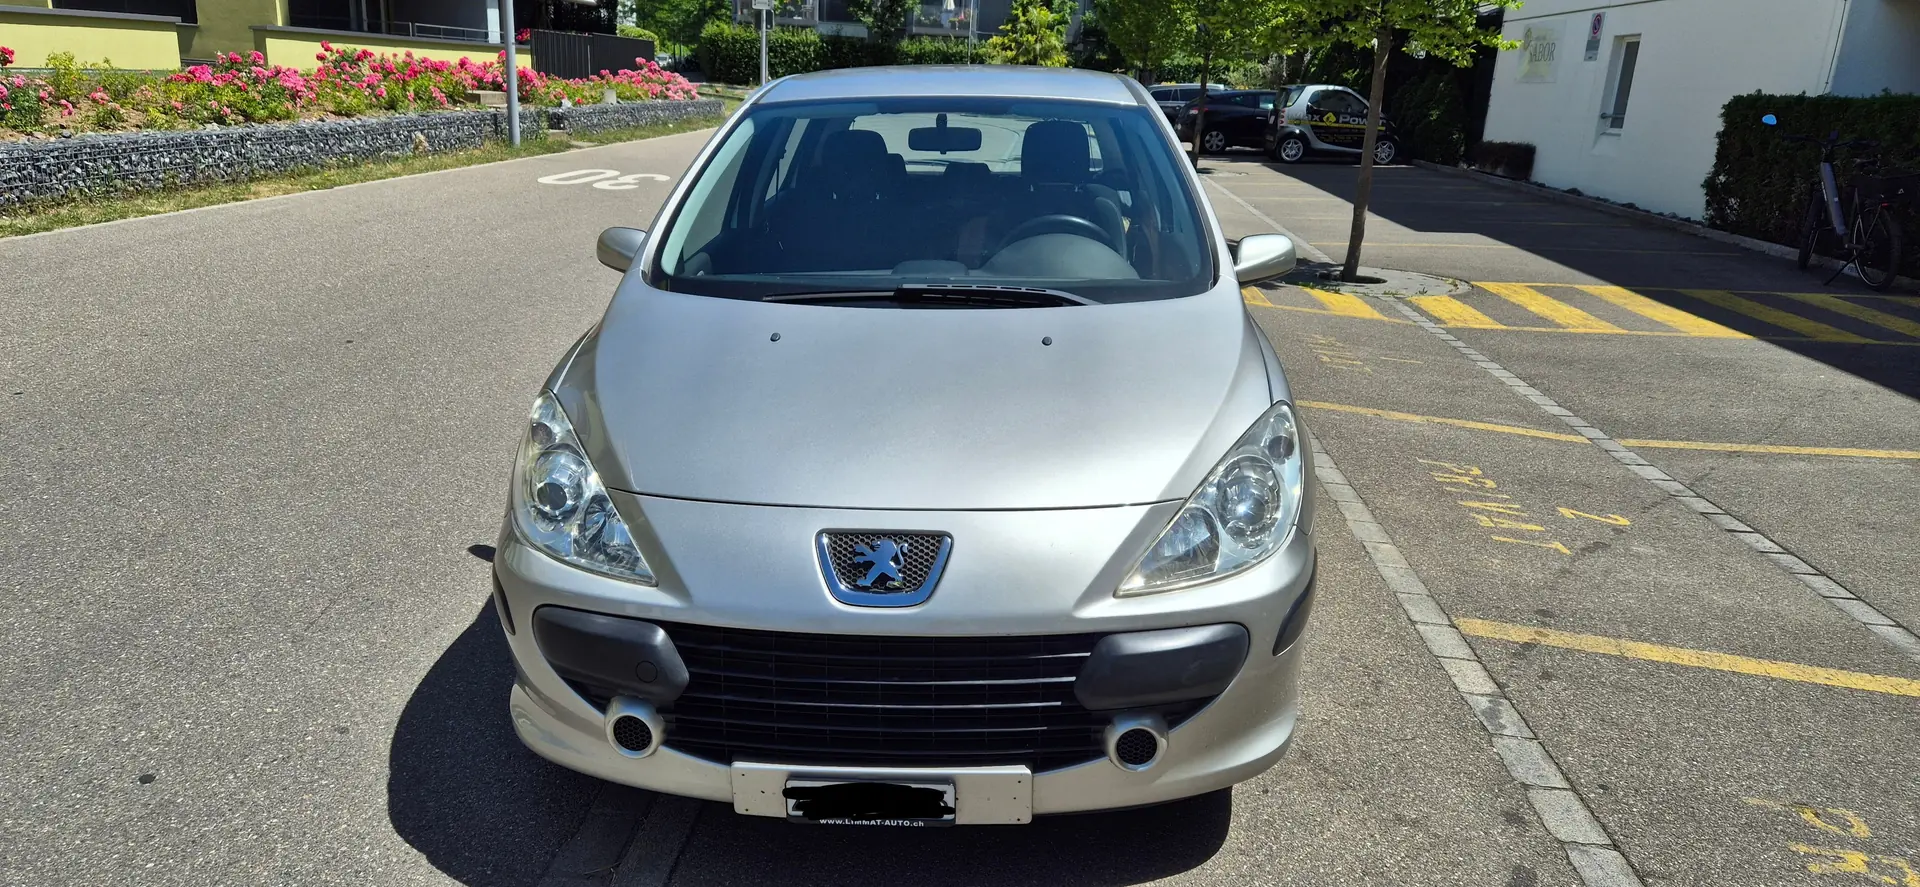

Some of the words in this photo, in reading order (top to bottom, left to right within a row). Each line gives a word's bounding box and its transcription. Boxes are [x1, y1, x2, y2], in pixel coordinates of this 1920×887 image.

[1529, 42, 1556, 61] SABOR
[1339, 114, 1386, 125] Powr
[537, 169, 670, 190] 30
[1556, 507, 1631, 526] 2
